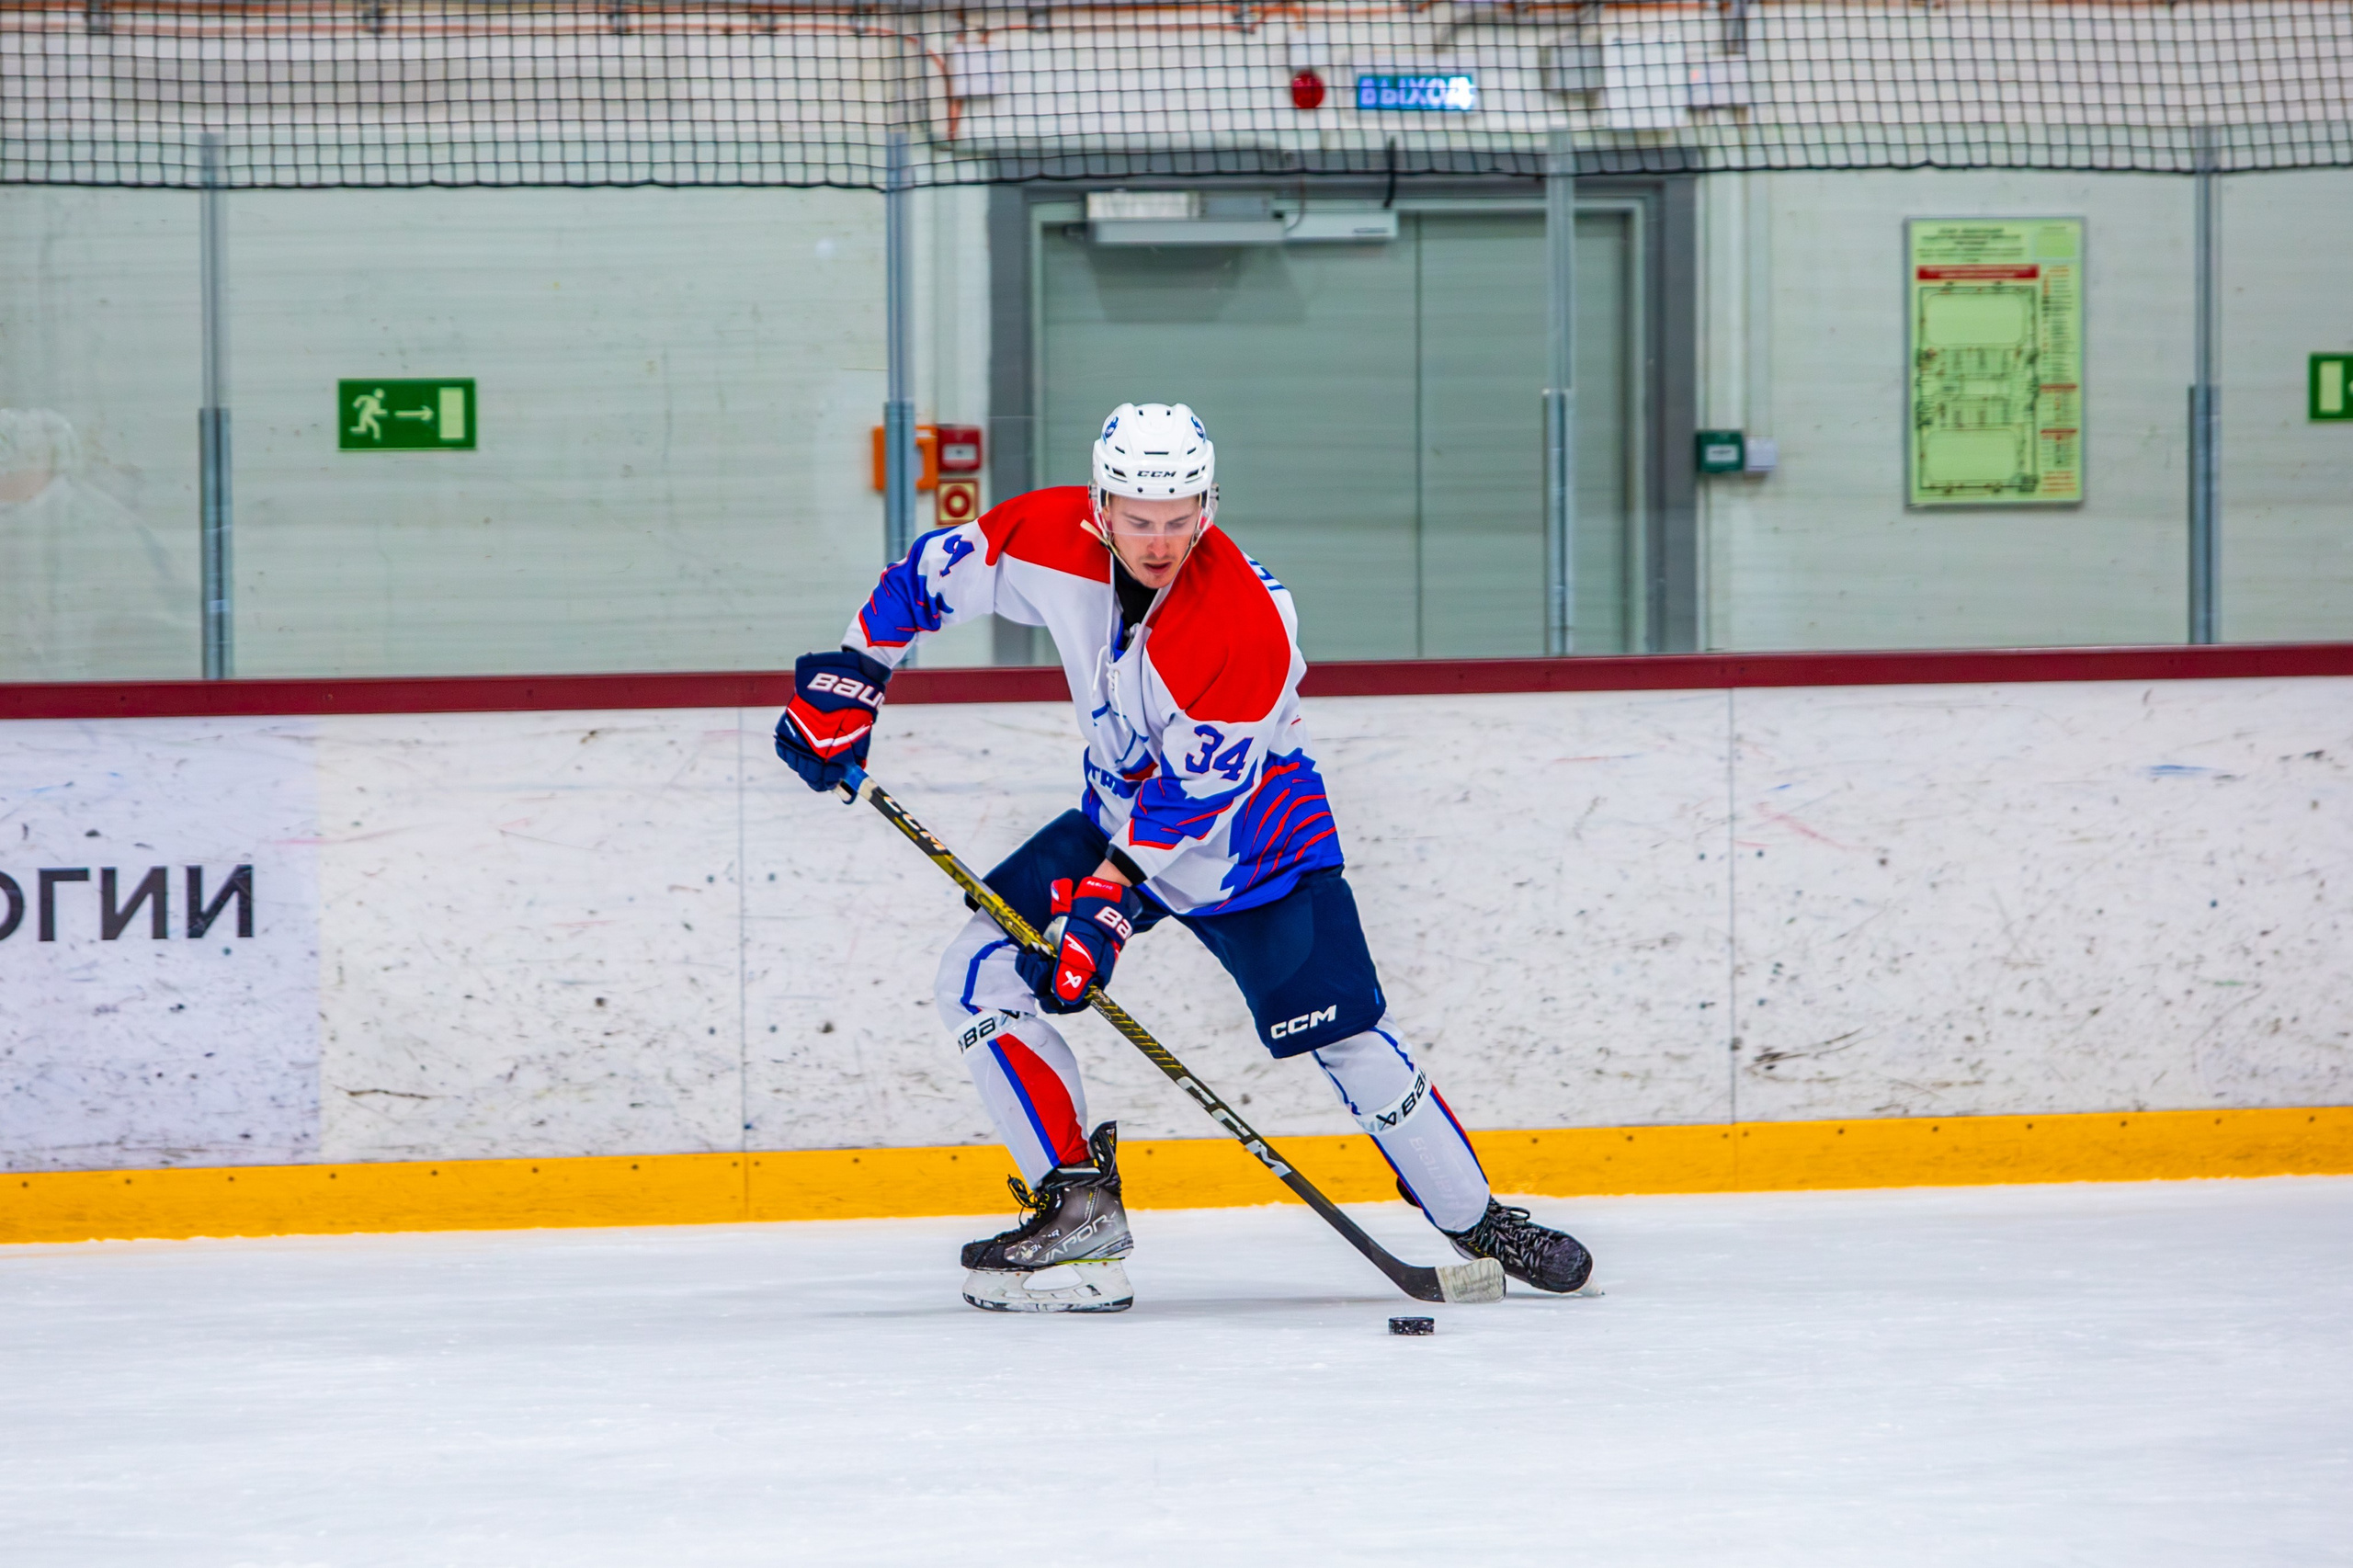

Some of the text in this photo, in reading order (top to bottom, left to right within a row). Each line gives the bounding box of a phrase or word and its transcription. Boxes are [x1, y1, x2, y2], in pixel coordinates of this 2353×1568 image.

[1137, 470, 1177, 478] CCM
[1185, 723, 1254, 781] 34
[883, 796, 948, 851] CCM
[948, 863, 1027, 941] TACKS
[1270, 1005, 1337, 1040] CCM
[1176, 1075, 1291, 1177] CCM
[1036, 1213, 1113, 1264] VAPOR
